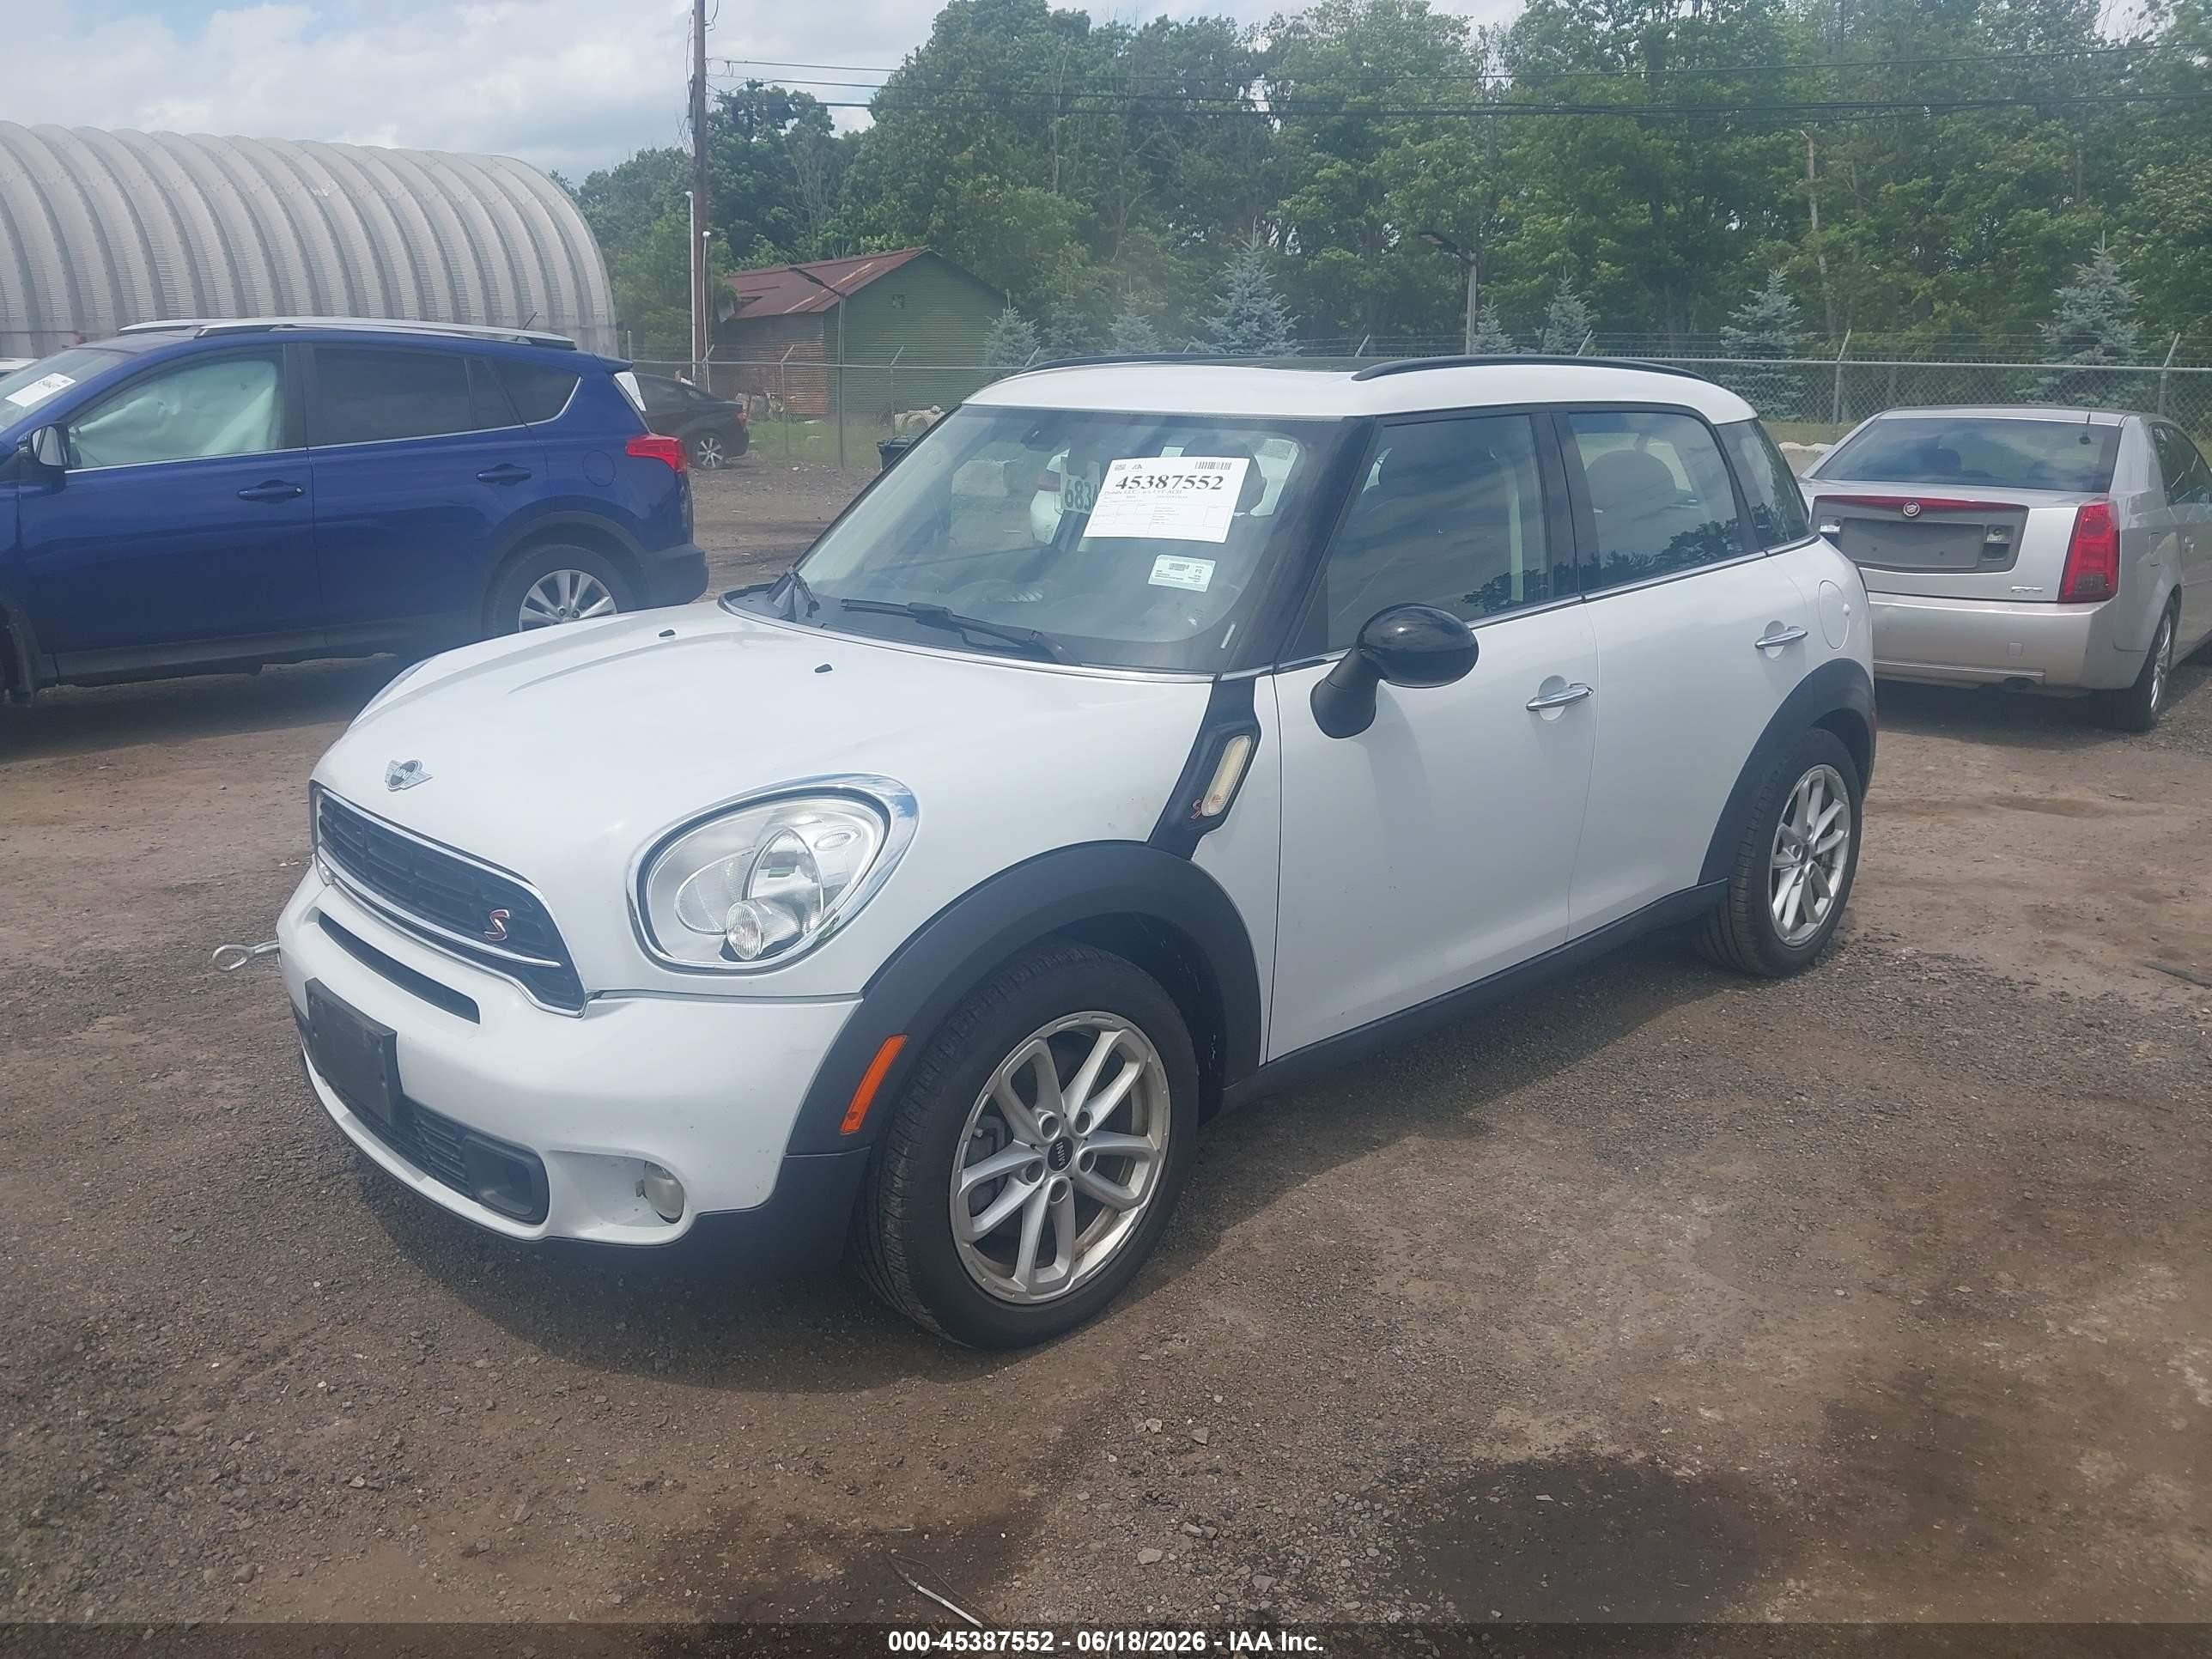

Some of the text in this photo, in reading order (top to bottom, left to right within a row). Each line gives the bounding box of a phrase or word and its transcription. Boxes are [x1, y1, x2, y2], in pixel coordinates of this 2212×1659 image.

[1115, 475, 1224, 490] 45387552
[483, 908, 511, 941] S
[1055, 1141, 1066, 1167] MINI
